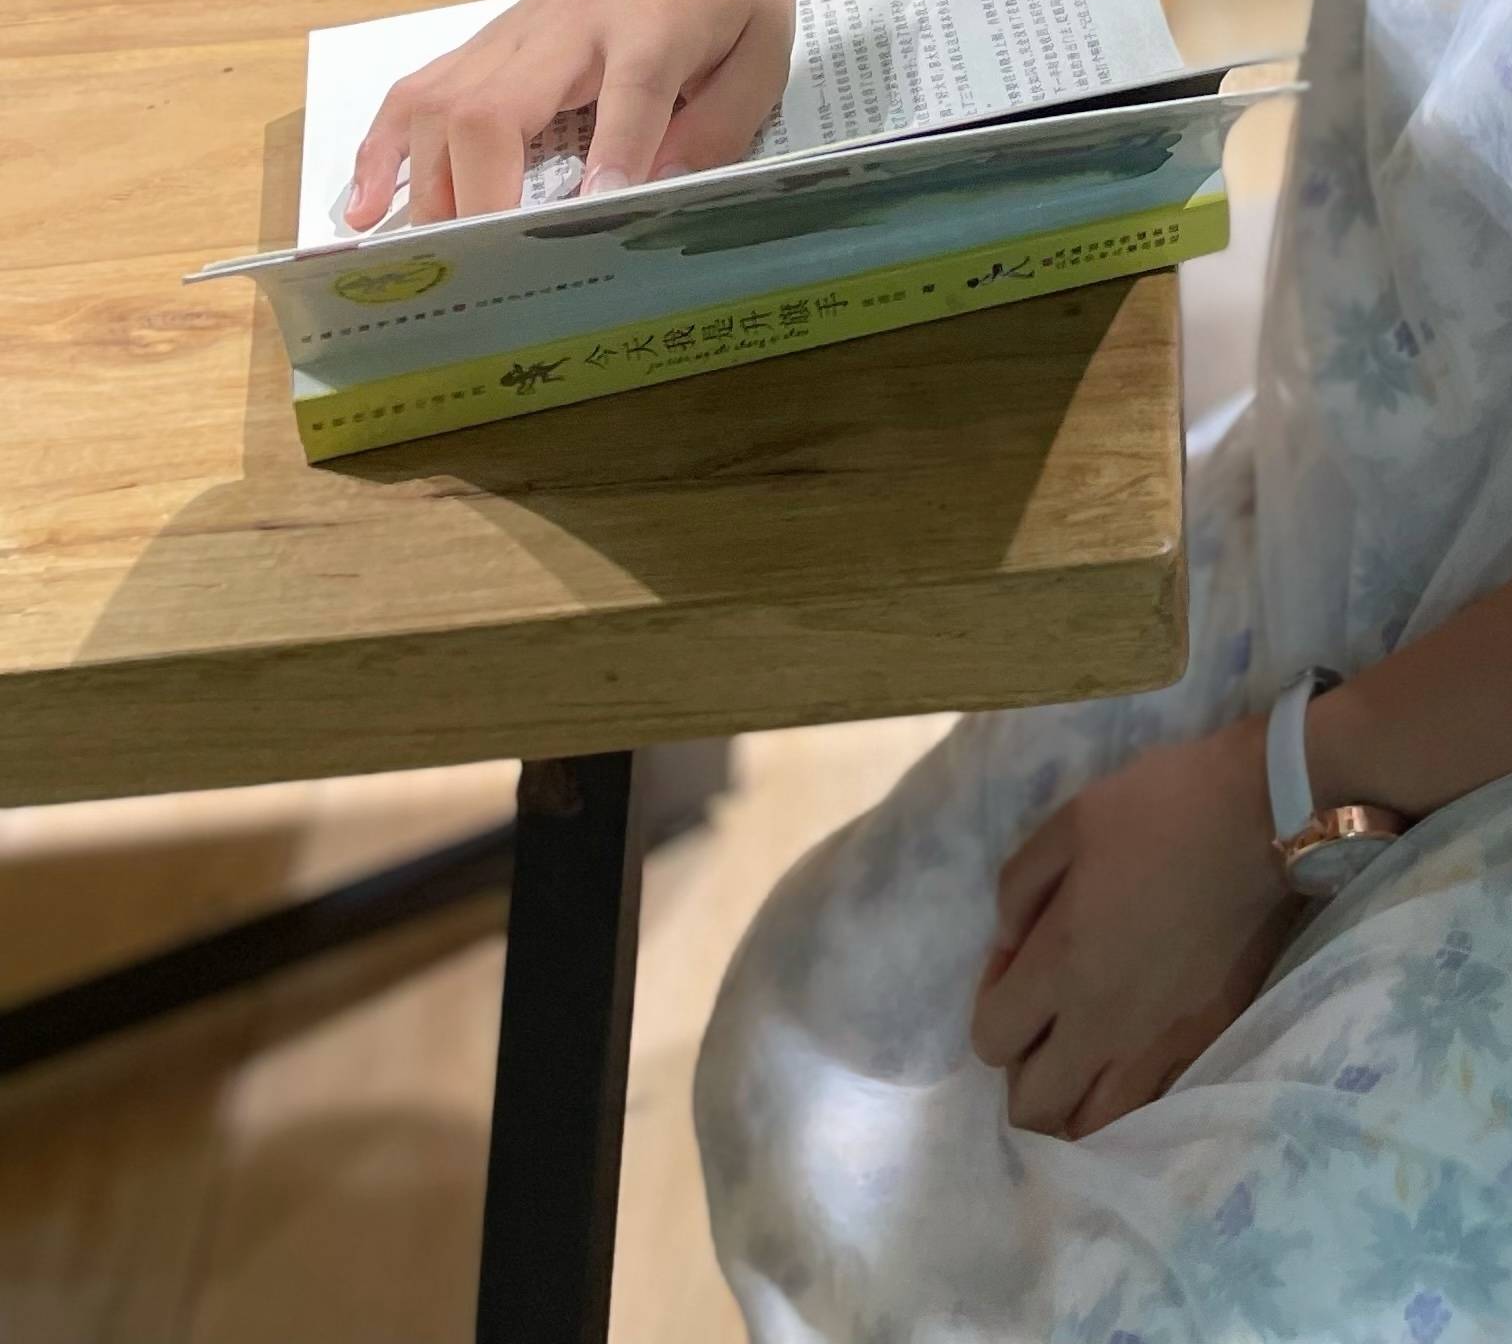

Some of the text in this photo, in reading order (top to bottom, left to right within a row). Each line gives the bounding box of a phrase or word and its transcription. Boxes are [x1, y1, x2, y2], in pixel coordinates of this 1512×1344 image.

[585, 293, 848, 369] 今天我是升旗手
